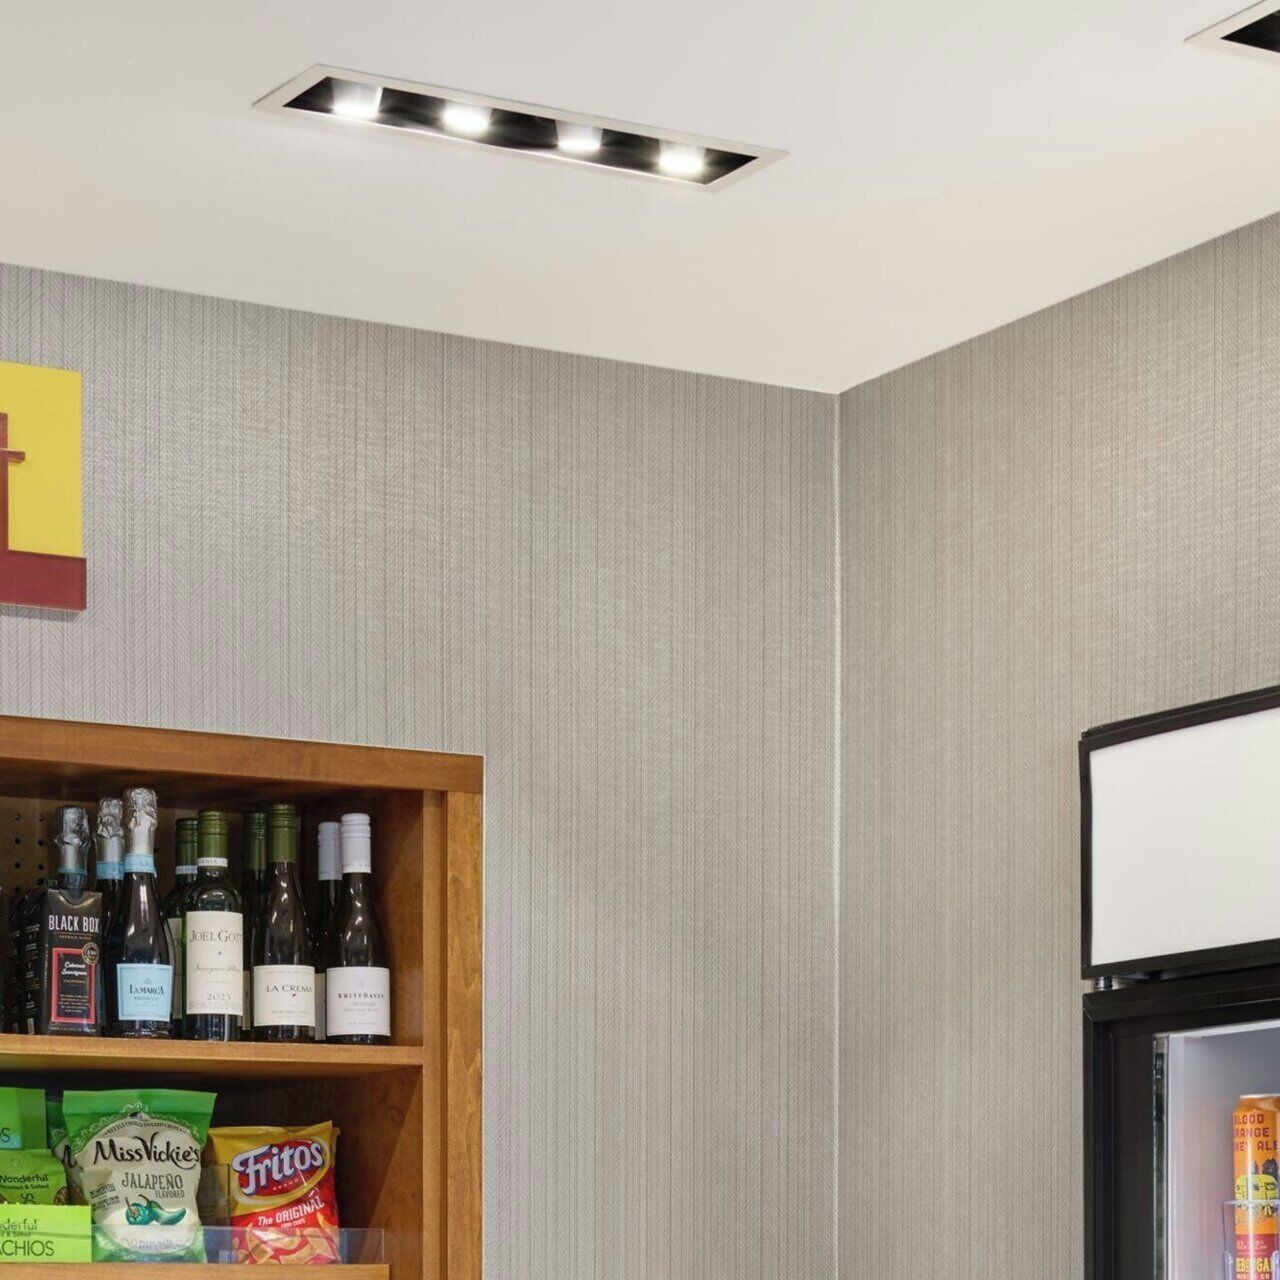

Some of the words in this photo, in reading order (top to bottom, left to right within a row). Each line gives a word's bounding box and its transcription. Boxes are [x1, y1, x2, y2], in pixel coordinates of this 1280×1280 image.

[49, 915, 80, 932] BLACK
[83, 917, 99, 933] BOX
[94, 1140, 143, 1164] Miss
[133, 1133, 199, 1169] Vickie's
[121, 1172, 183, 1190] JALAPEÑO
[232, 1141, 324, 1195] Fritos
